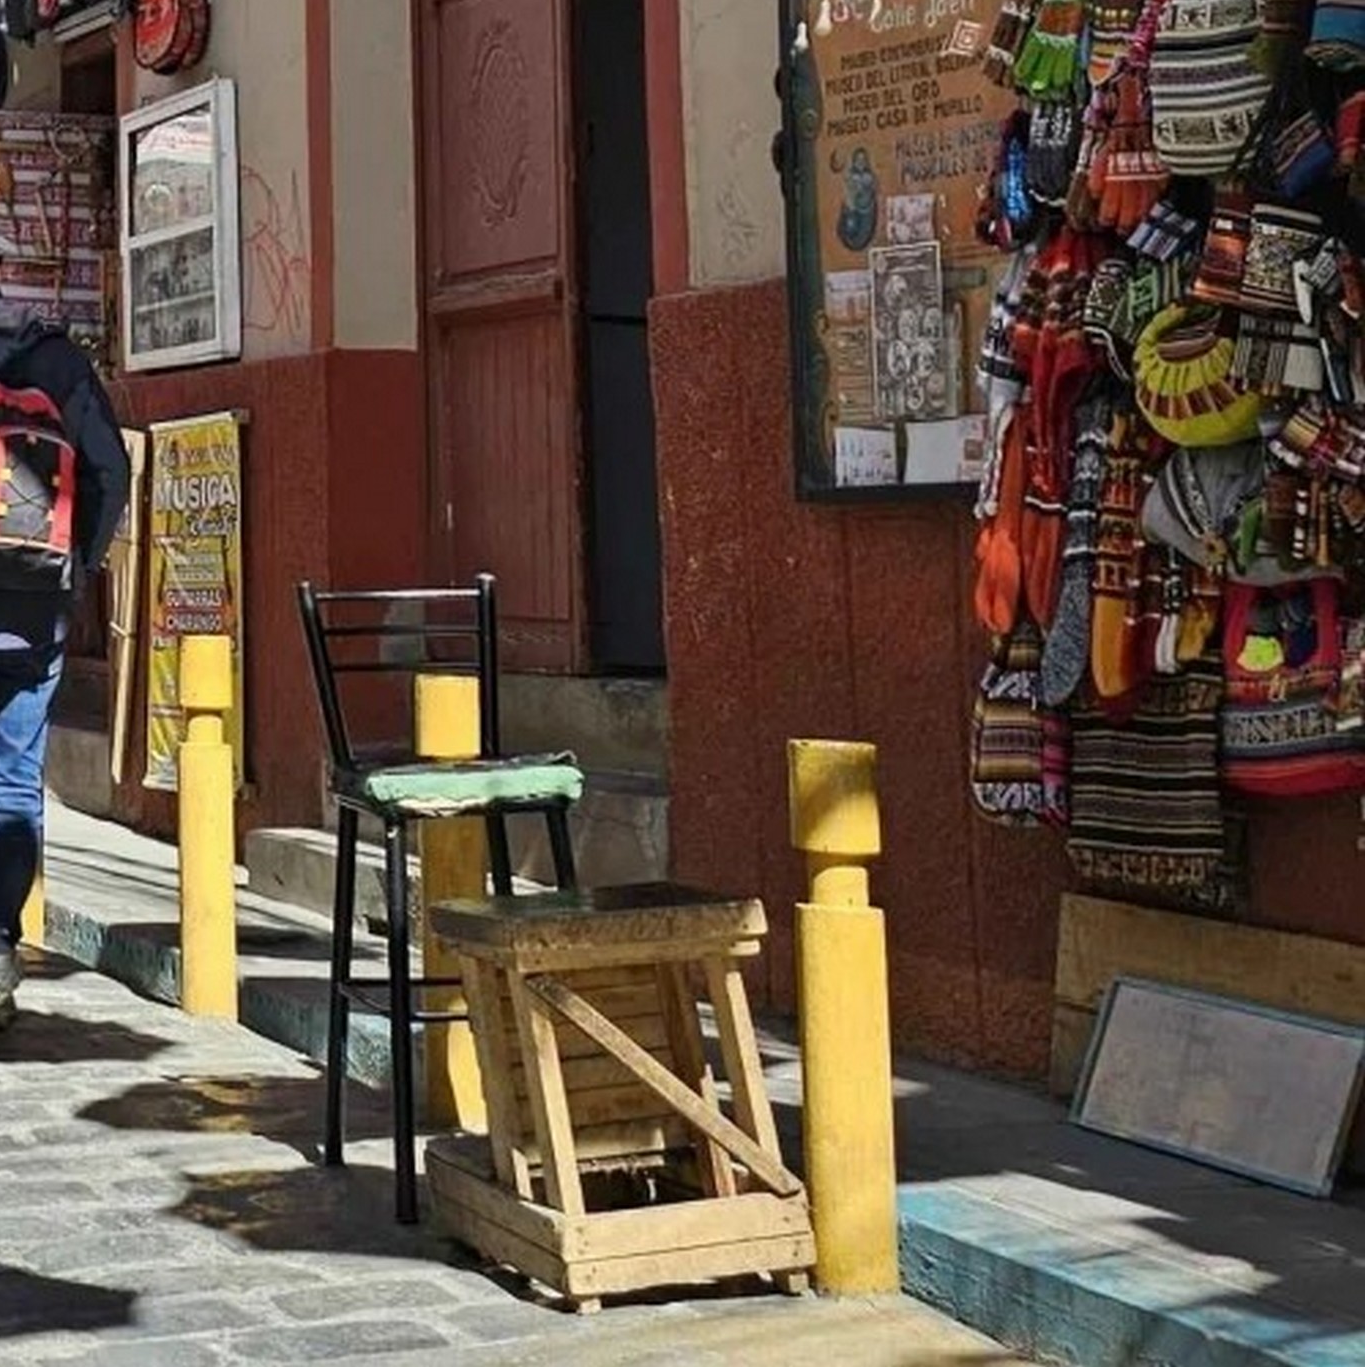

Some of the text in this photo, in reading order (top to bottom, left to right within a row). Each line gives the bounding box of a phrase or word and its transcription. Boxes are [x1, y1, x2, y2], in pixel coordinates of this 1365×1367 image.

[841, 50, 877, 71] MUSEO
[825, 72, 863, 95] MUSEO
[866, 69, 886, 90] DEL
[843, 79, 941, 115] MUSEO DEL ORO
[827, 114, 869, 137] MUSEO
[875, 107, 909, 130] CASA
[913, 104, 928, 126] DE
[154, 474, 237, 511] MUSICA
